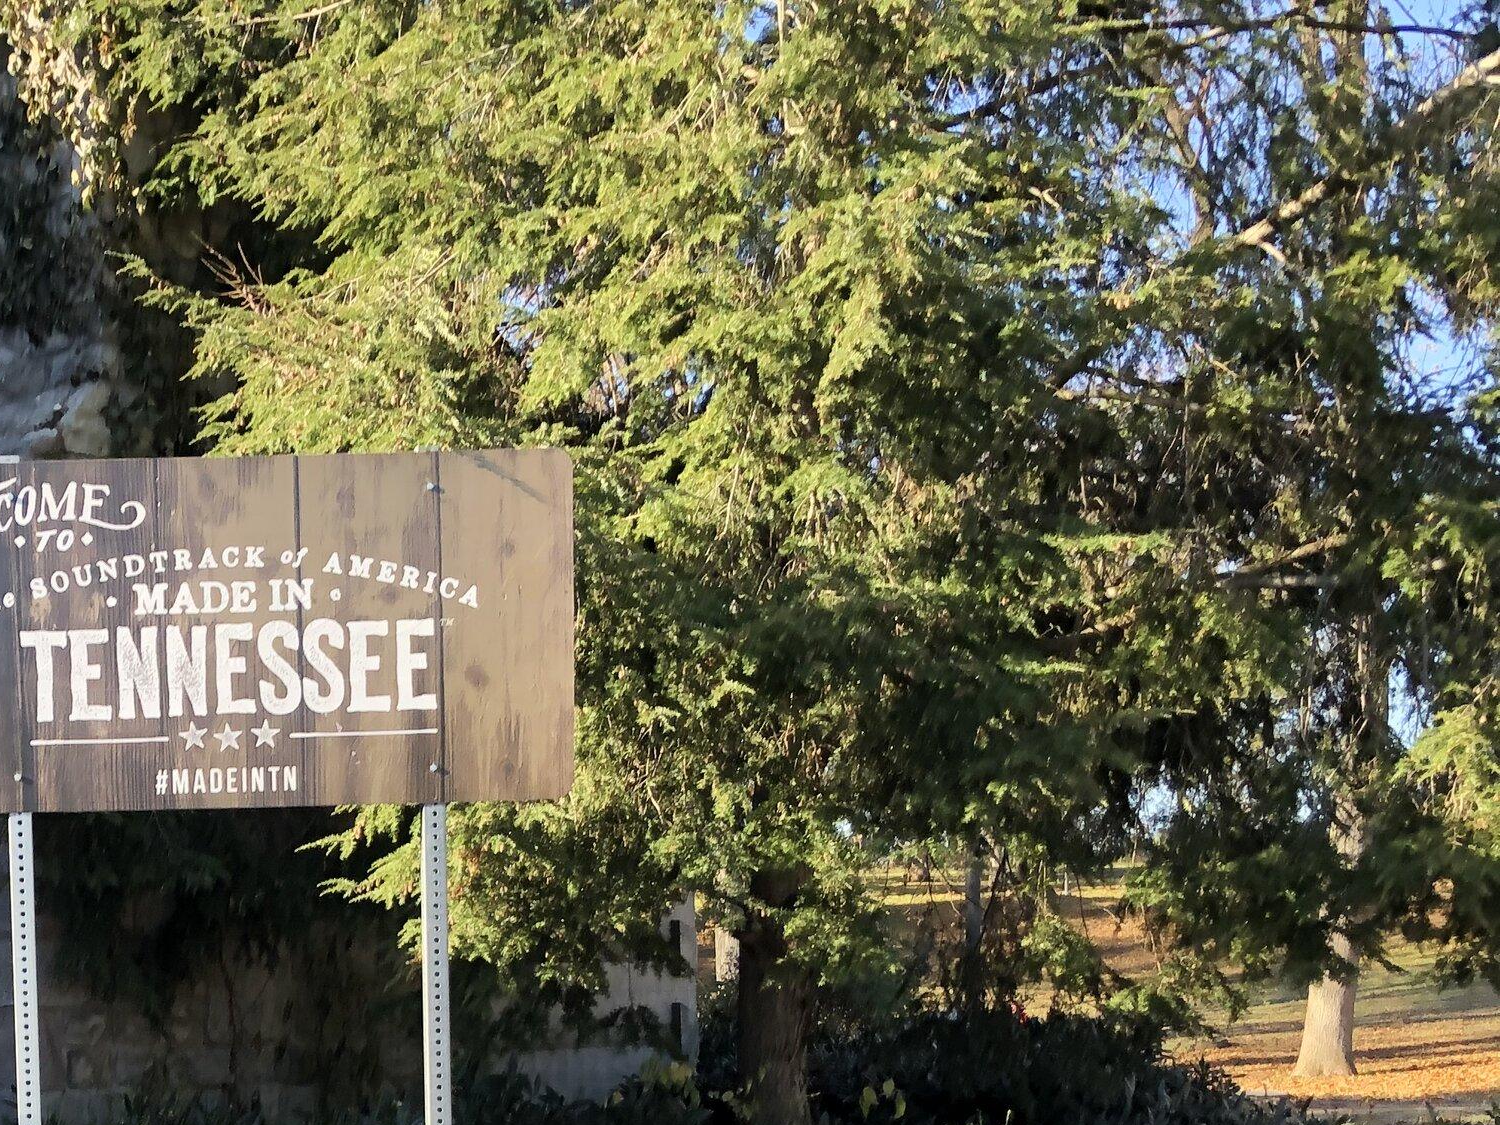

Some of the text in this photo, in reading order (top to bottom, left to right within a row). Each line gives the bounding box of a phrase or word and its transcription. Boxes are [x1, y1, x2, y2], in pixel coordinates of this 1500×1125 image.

[36, 529, 75, 552] TO
[30, 545, 264, 599] SOUNDTRACK
[280, 547, 308, 568] of
[322, 552, 478, 608] AMERICA
[133, 578, 314, 616] MADE IN
[20, 618, 438, 723] TENNESSEE
[155, 765, 298, 796] #MADEINTN
